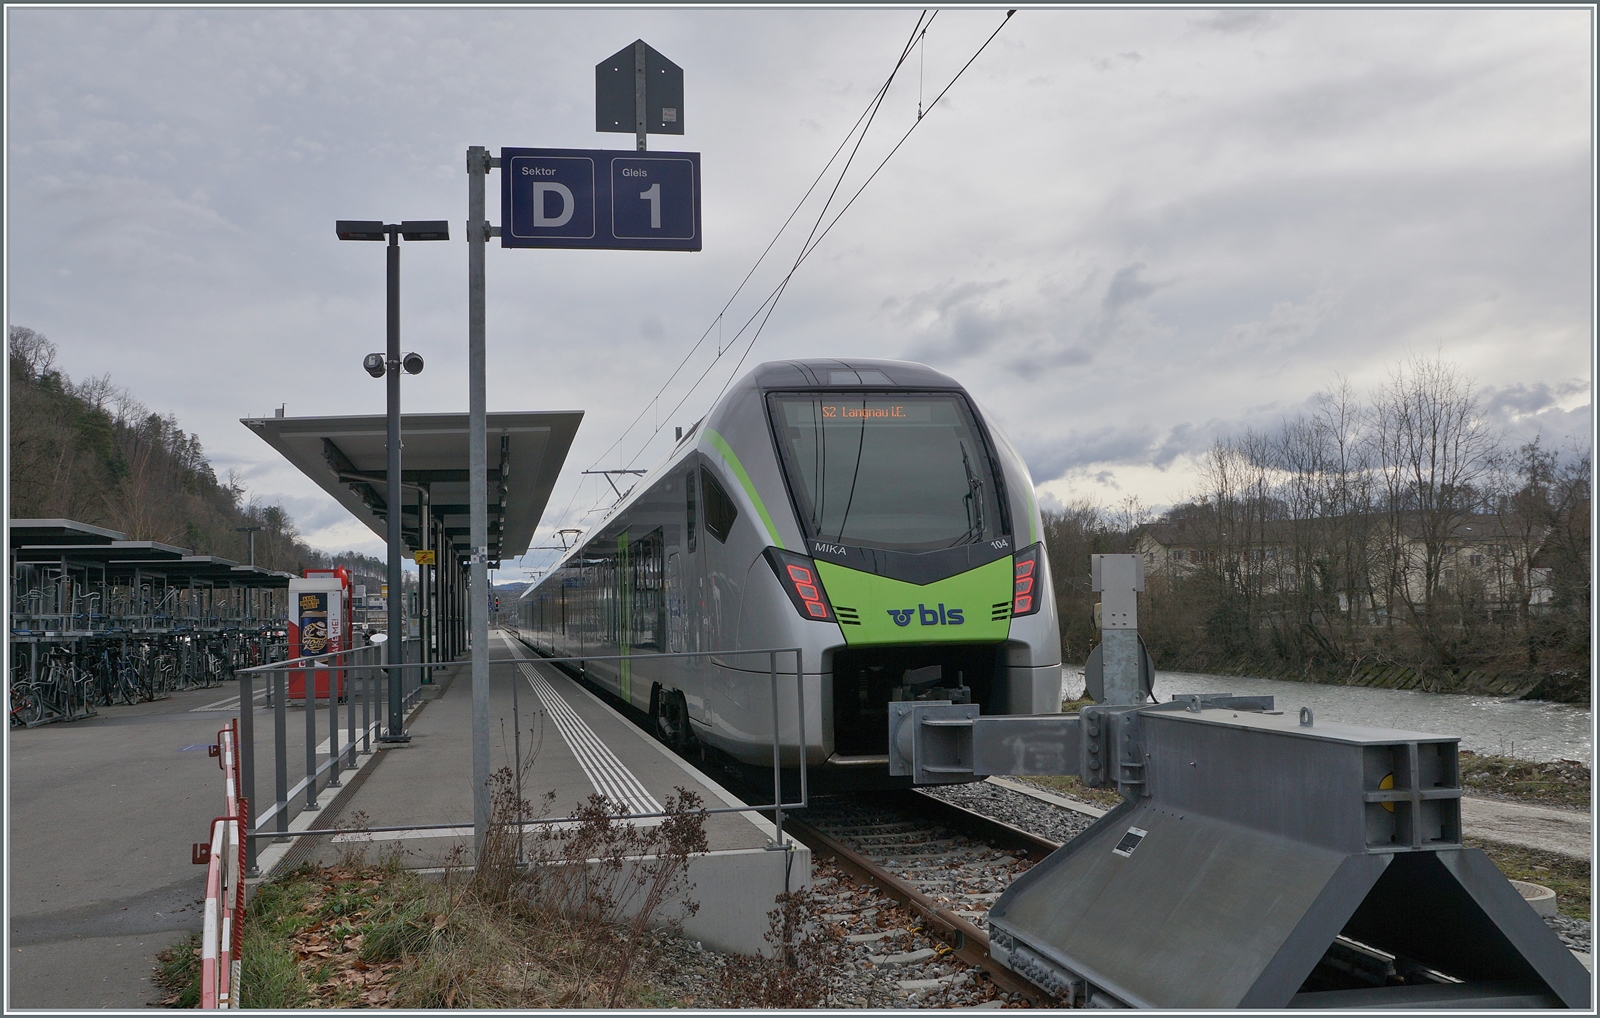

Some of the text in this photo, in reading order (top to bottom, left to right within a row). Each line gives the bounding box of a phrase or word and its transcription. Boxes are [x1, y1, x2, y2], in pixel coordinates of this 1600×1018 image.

[521, 166, 556, 176] Sektor
[622, 168, 648, 177] Gleis
[533, 181, 575, 228] D
[640, 183, 661, 228] 1
[822, 406, 906, 420] S2 Langnau i.E.
[815, 542, 847, 556] MIKA
[990, 538, 1009, 551] 104
[918, 603, 965, 626] bls
[331, 618, 339, 634] ME!
